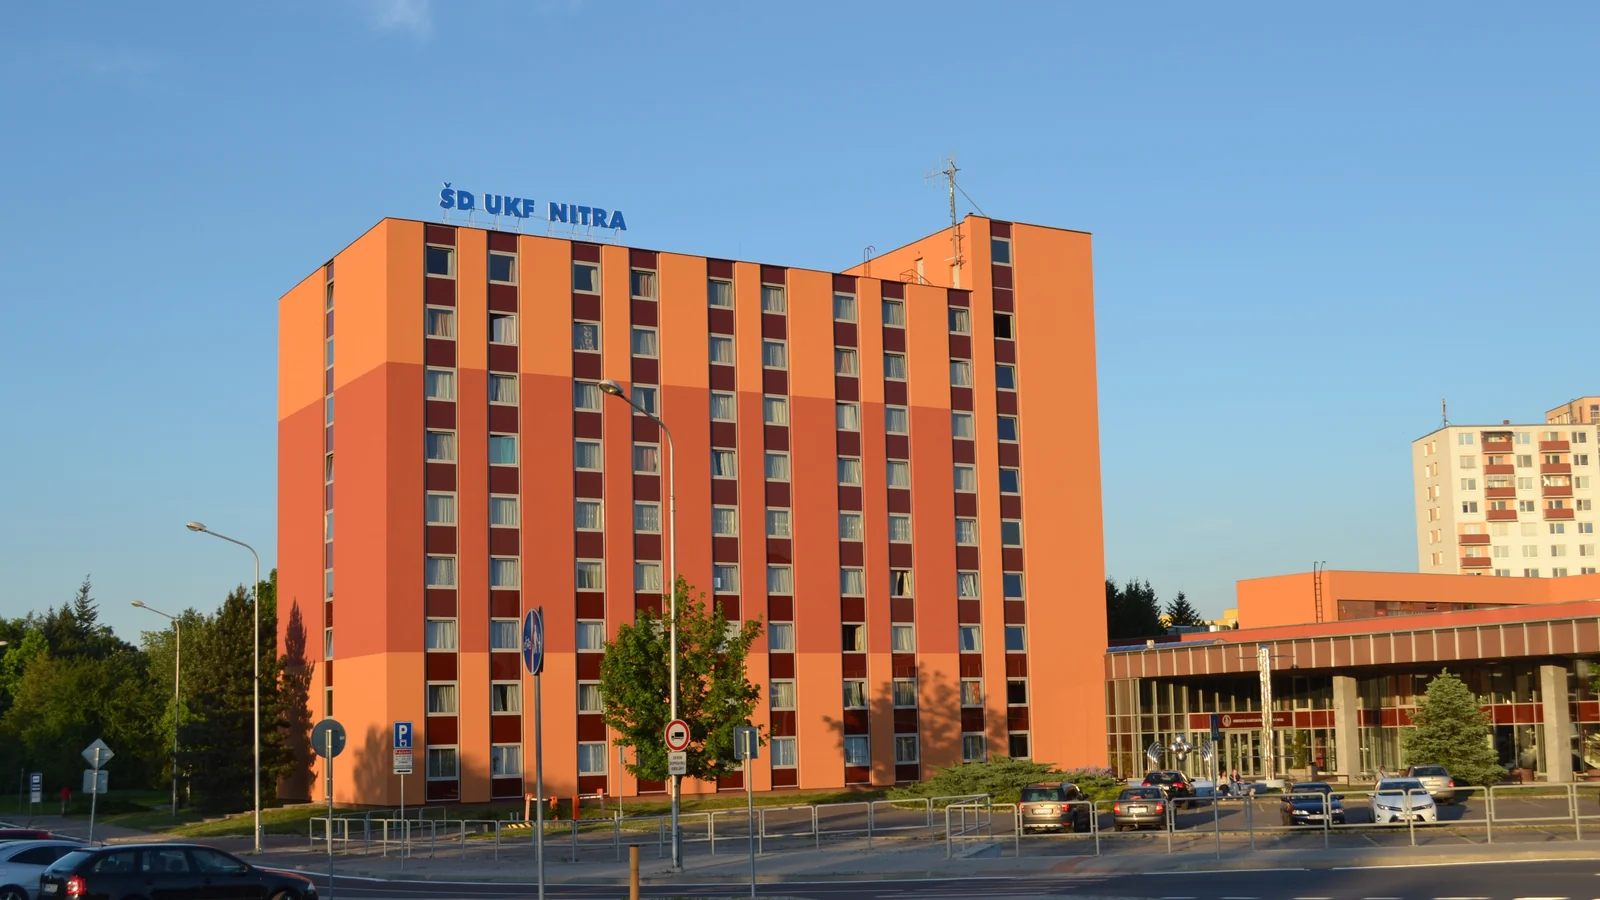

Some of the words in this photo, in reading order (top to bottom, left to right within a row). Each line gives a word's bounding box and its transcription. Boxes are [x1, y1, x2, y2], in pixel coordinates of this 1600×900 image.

[439, 182, 475, 211] ŠD
[483, 193, 535, 219] UKF
[548, 201, 627, 231] NITRA
[398, 724, 408, 740] P
